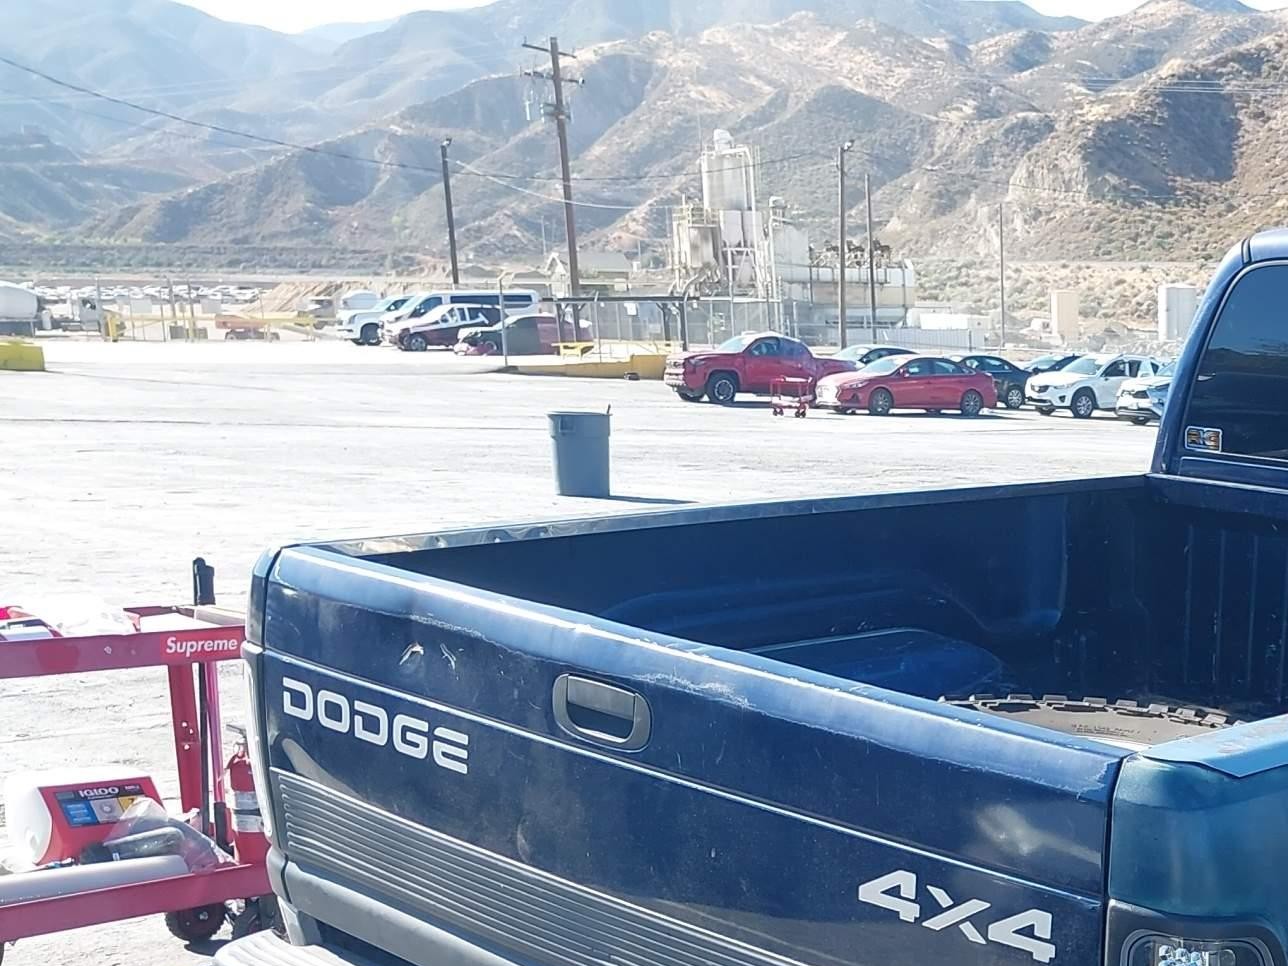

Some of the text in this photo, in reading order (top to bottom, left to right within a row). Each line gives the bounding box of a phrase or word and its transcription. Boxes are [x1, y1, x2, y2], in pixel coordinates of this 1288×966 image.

[165, 636, 238, 656] Supreme
[281, 676, 469, 775] DODGE
[78, 786, 119, 798] IGLOO
